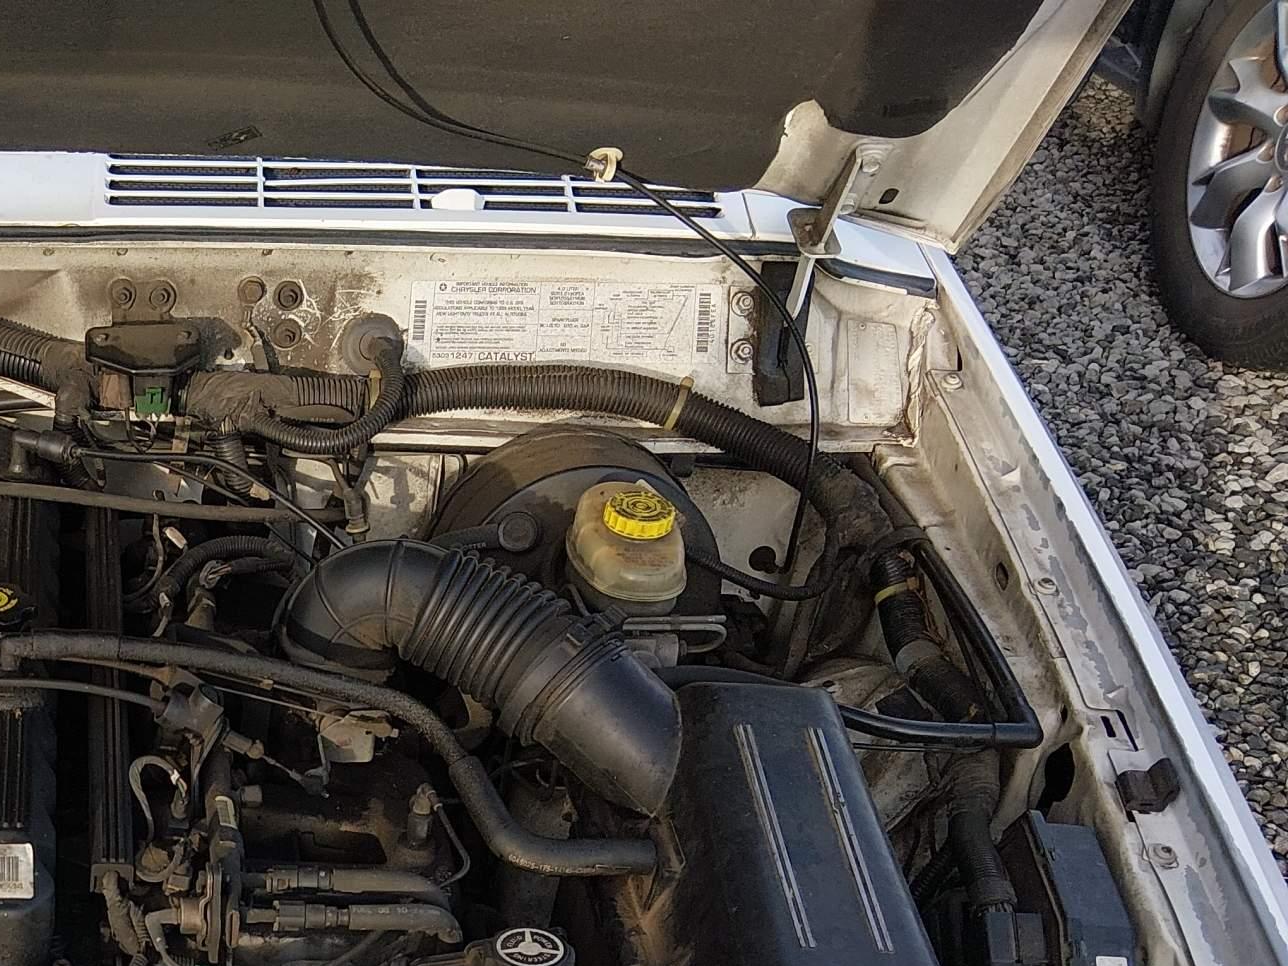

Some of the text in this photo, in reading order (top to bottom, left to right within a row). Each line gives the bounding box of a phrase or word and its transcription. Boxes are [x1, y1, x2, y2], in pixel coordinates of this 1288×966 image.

[478, 352, 534, 361] CATALYST
[533, 935, 553, 948] POWER
[513, 953, 550, 962] STEERING
